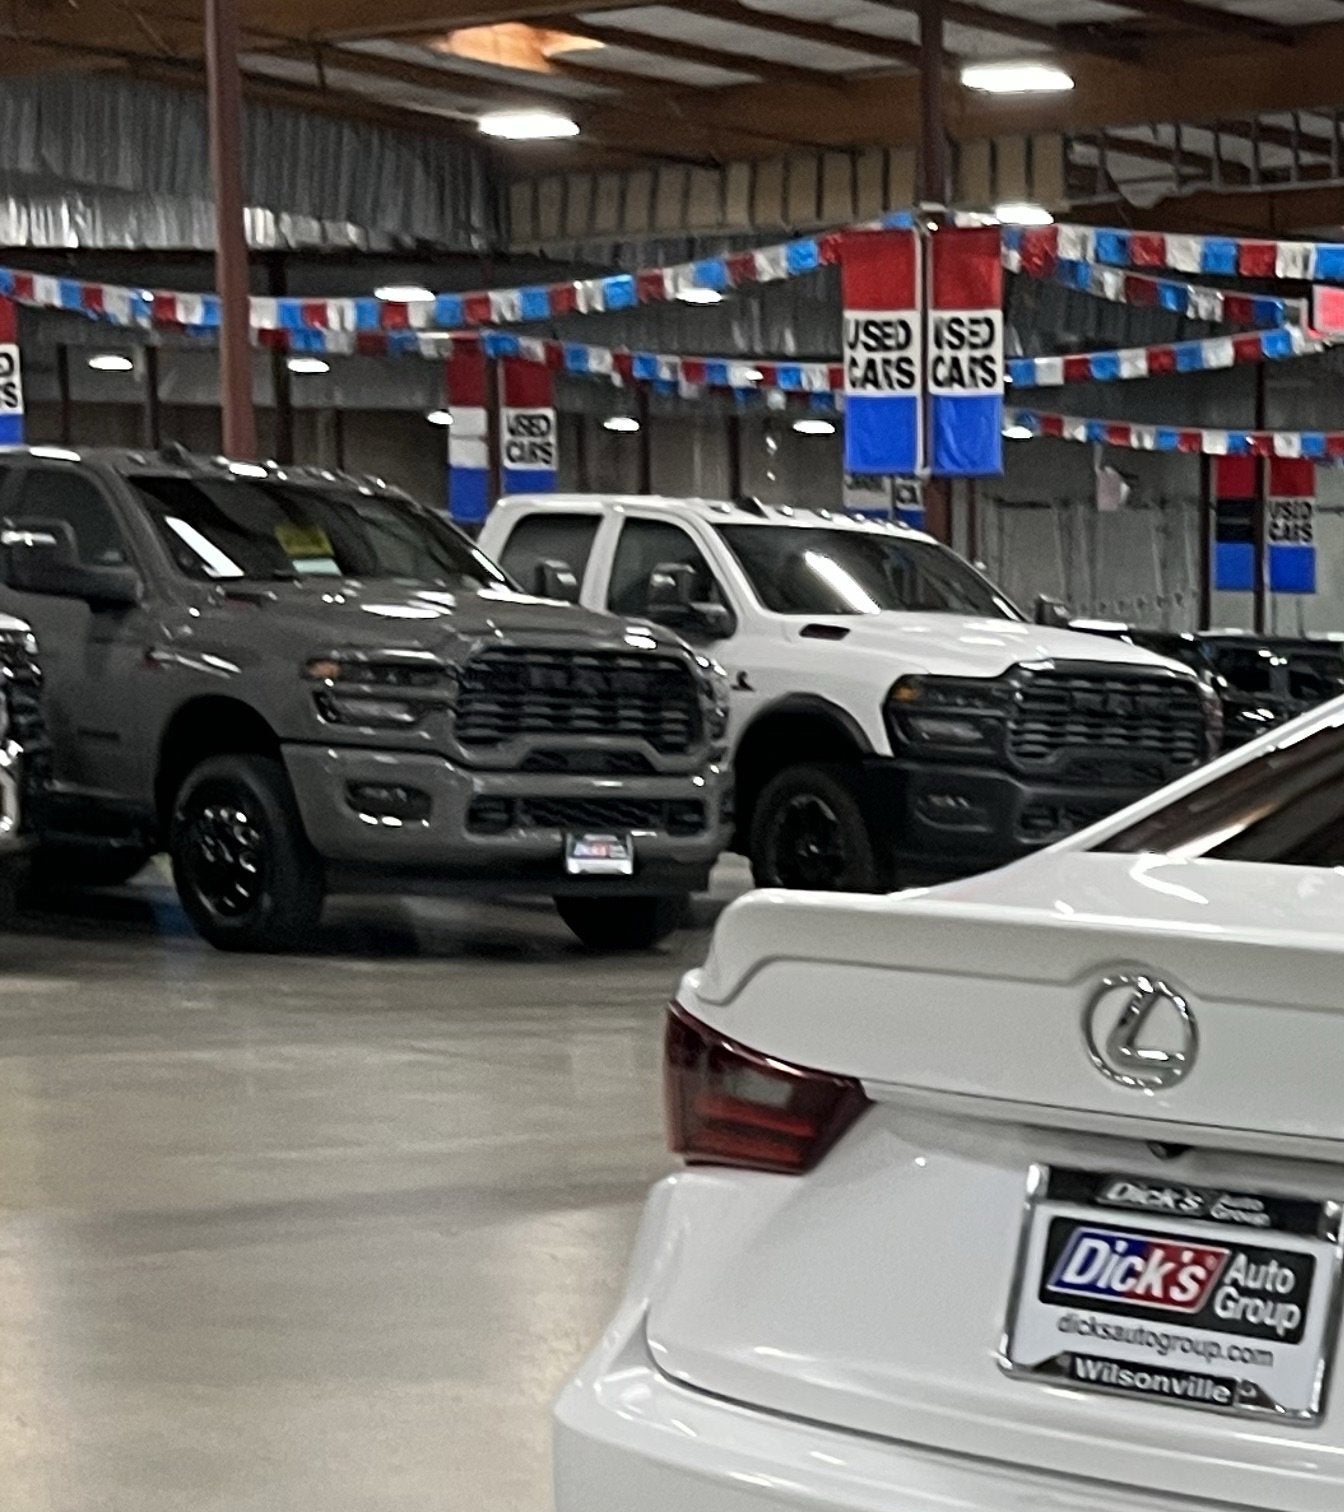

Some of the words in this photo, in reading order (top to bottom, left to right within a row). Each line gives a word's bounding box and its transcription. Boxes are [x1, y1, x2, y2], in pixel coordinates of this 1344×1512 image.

[1061, 1238, 1206, 1303] Dick's
[1223, 1253, 1296, 1295] Auto
[1213, 1286, 1302, 1337] Group
[1057, 1311, 1275, 1367] dicksautogroup.com
[1075, 1358, 1232, 1404] Wilsonville
